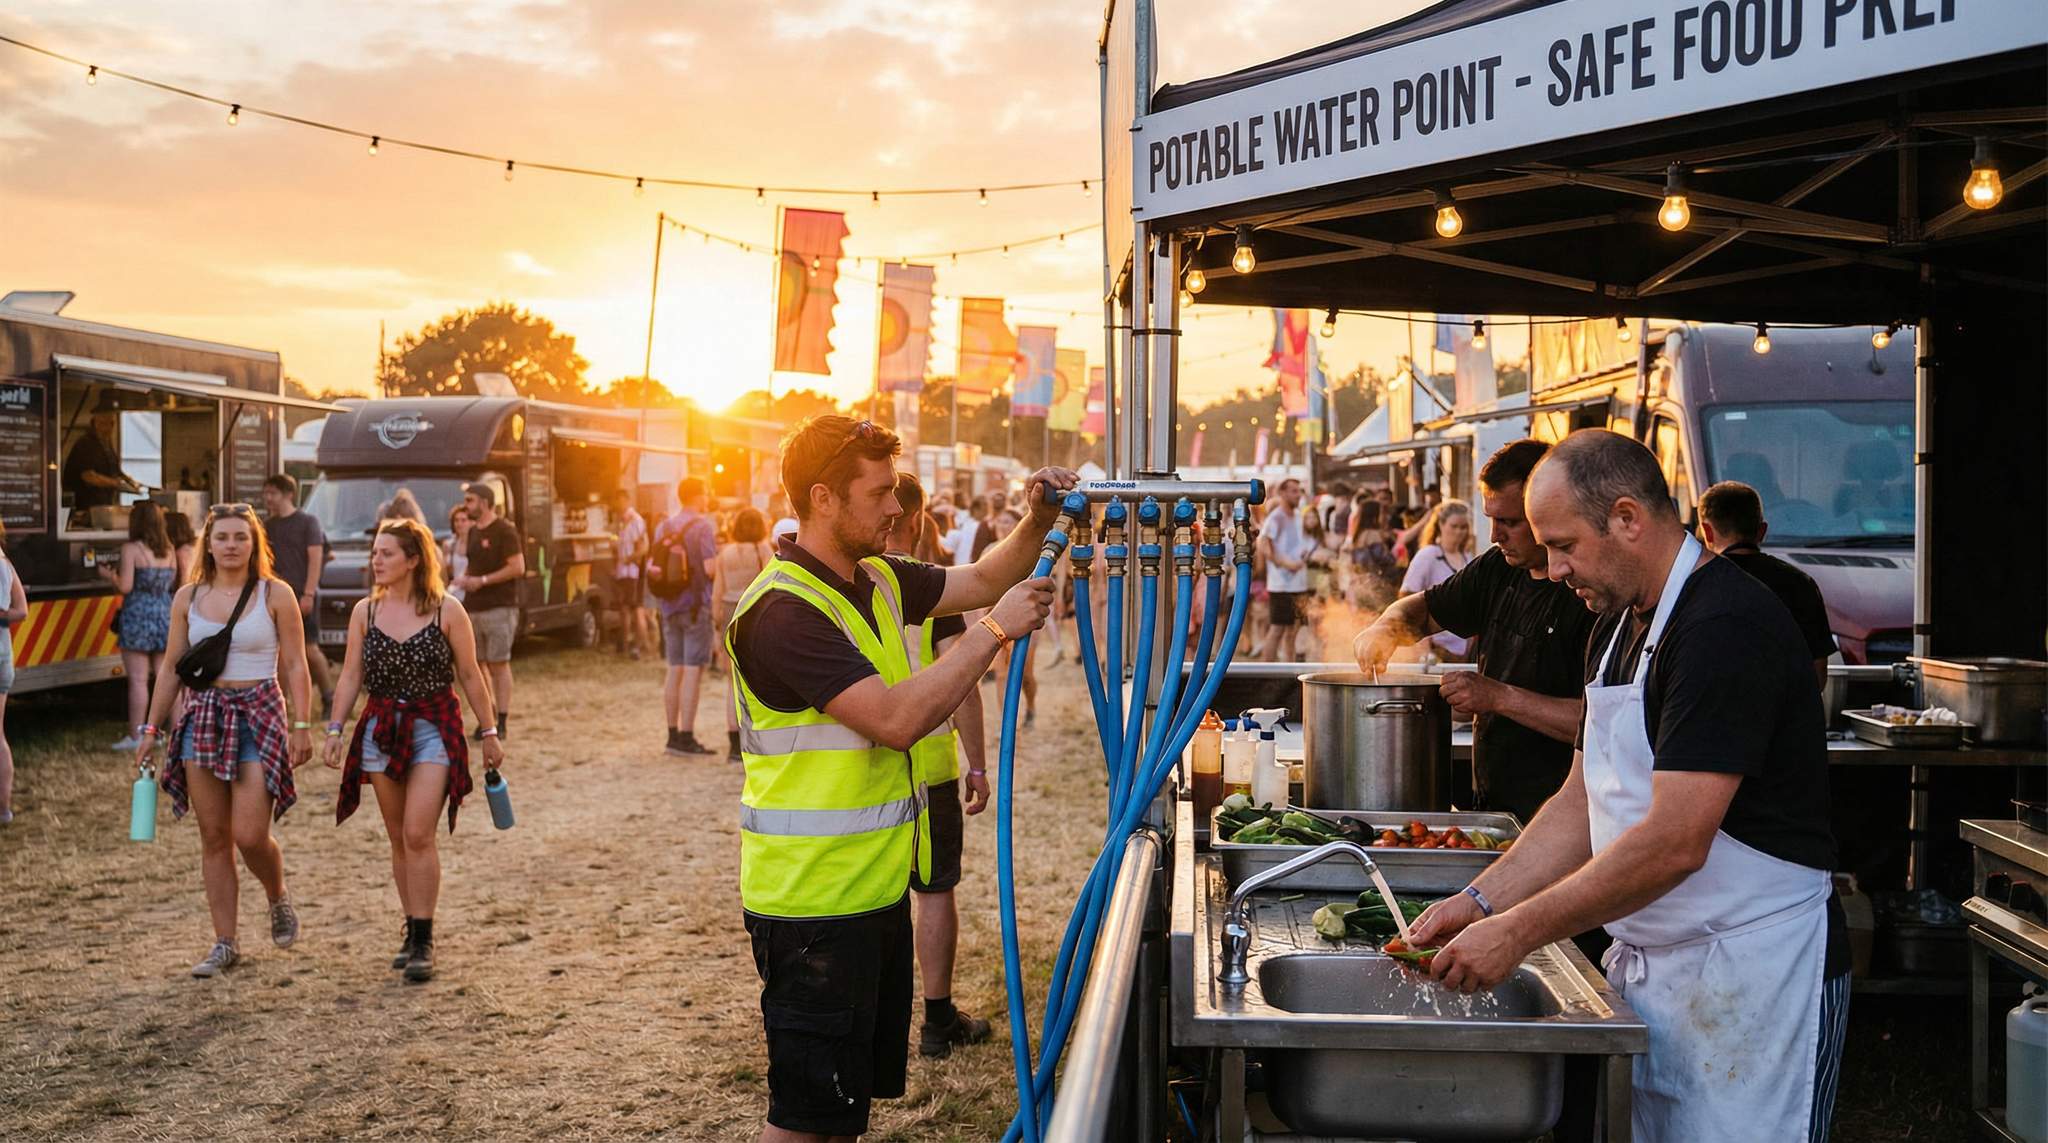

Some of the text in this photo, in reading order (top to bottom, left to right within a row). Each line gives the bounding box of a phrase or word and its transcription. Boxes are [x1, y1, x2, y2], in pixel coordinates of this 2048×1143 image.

[1149, 116, 1264, 195] POTABLE
[1273, 88, 1380, 168] WATER
[1393, 56, 1502, 141] POINT
[1515, 76, 1531, 88] -
[1547, 18, 1656, 107] SAFE
[1673, 0, 1803, 81] FOOD
